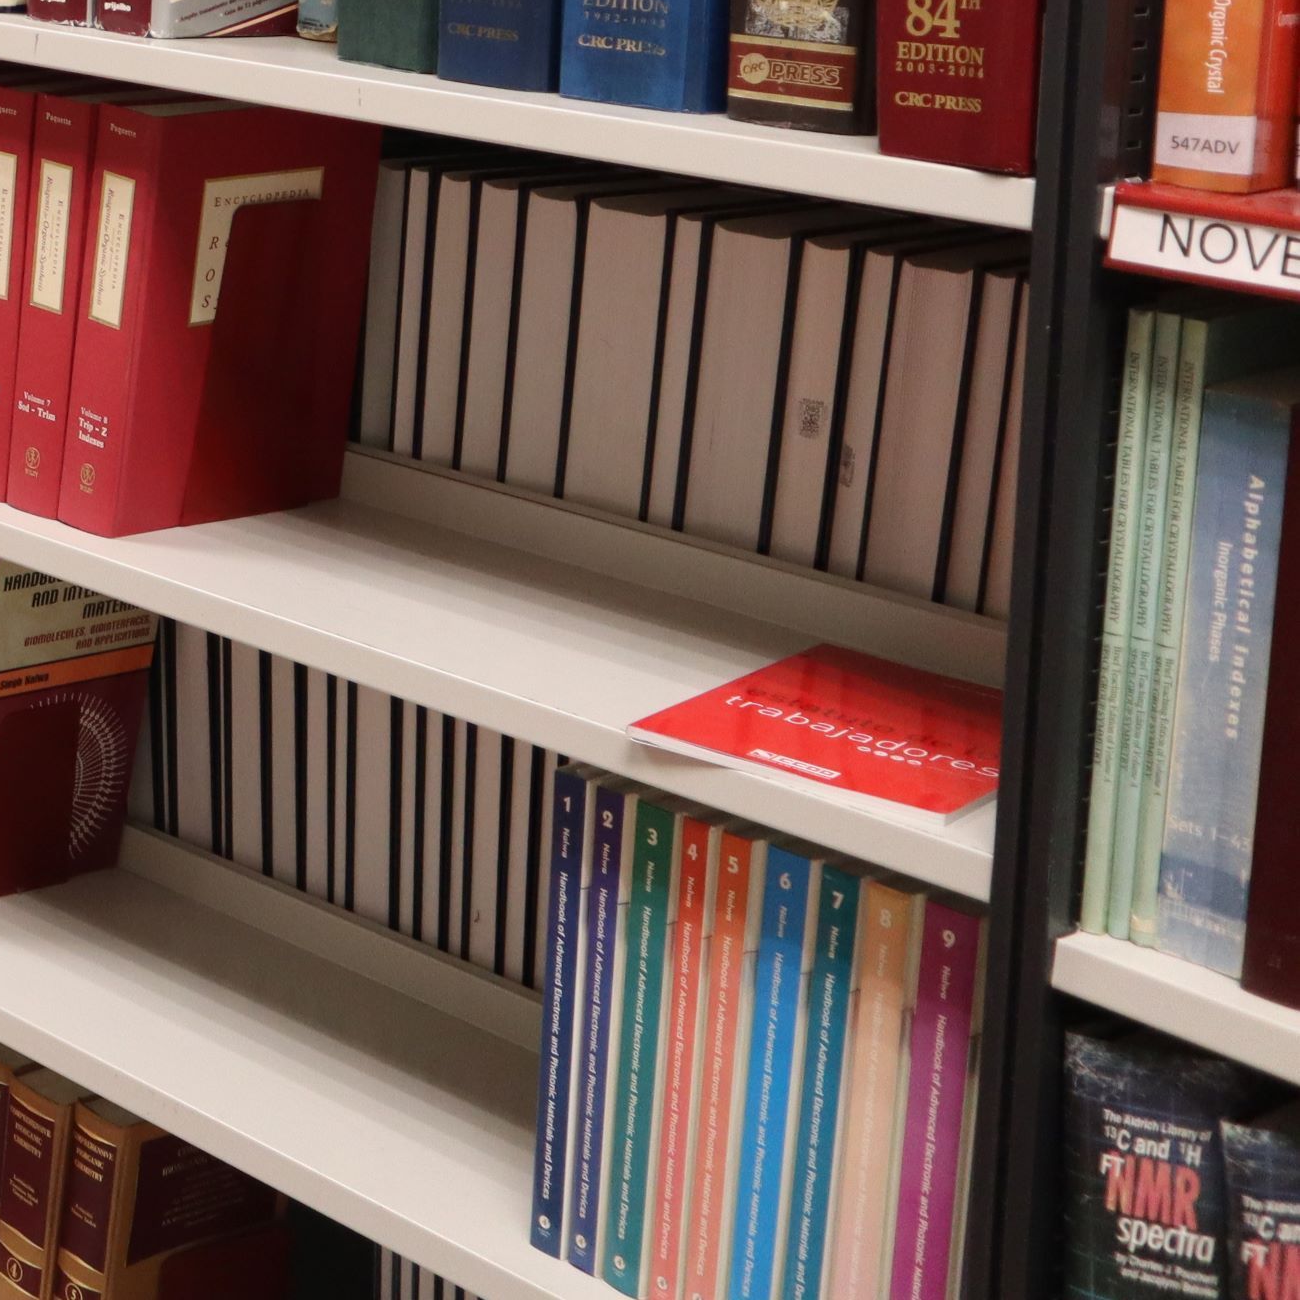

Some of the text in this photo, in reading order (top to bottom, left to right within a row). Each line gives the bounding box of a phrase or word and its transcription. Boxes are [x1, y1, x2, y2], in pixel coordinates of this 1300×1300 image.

[104, 1, 132, 13] grijalbo
[895, 41, 985, 66] EDITION
[1206, 45, 1228, 94] Crystal
[894, 91, 983, 113] CRC PRESS
[1170, 134, 1241, 156] 547ADV
[79, 431, 105, 449] Indexes
[1209, 541, 1234, 662] Inorganic Phases
[725, 694, 1000, 778] trabajadores
[602, 810, 613, 829] 2
[647, 827, 658, 846] 3
[15, 1121, 43, 1146] INORGANIC
[1100, 1153, 1125, 1178] FT
[1105, 1148, 1201, 1233] NMR
[1116, 1216, 1217, 1265] spectra
